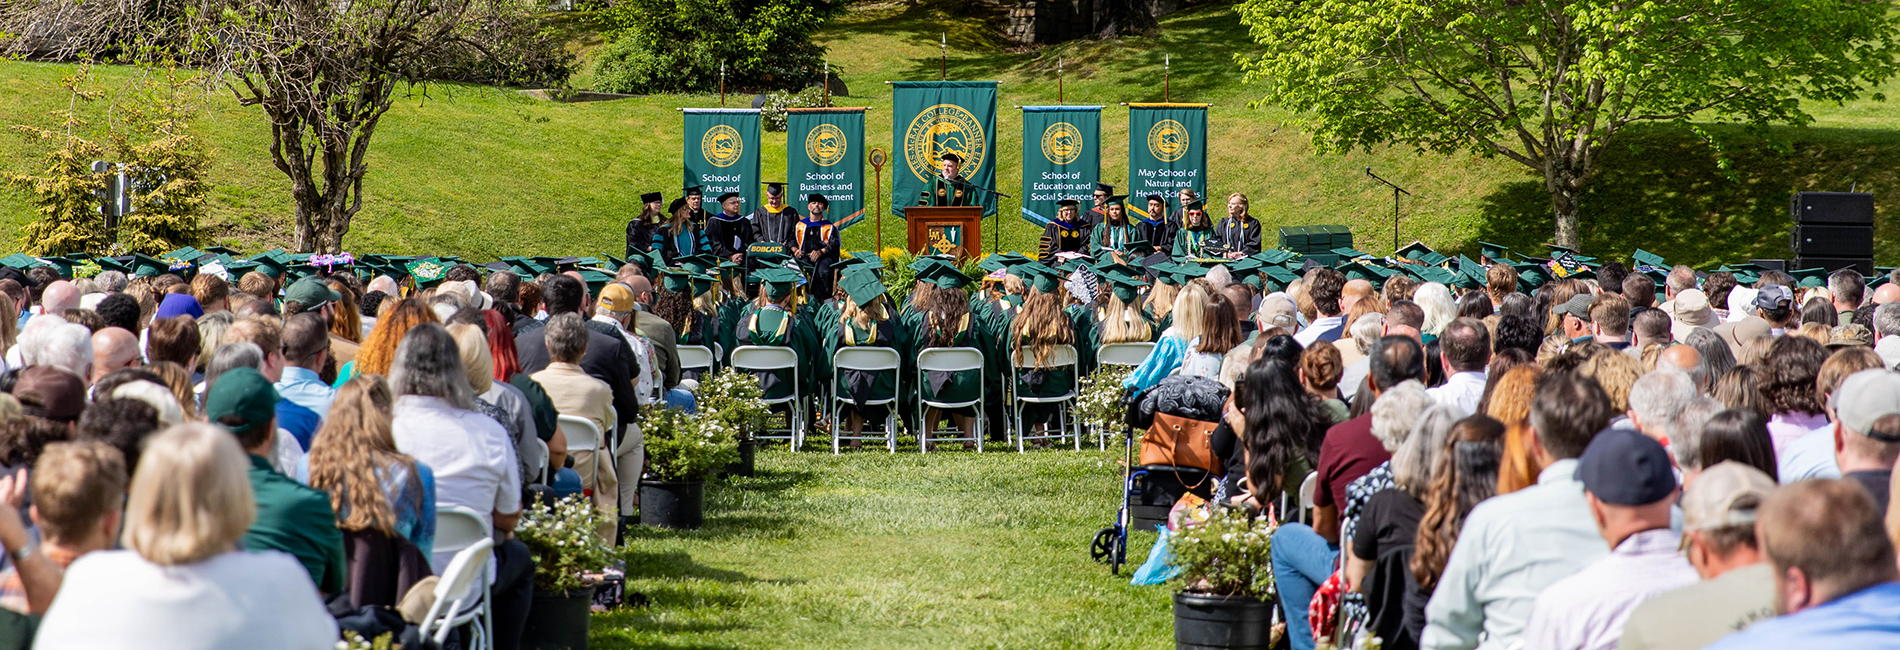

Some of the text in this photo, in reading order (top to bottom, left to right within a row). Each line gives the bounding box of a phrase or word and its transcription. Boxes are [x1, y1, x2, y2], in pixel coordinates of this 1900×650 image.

[921, 108, 960, 122] COLLEGE
[962, 115, 982, 149] BANNER
[806, 172, 845, 180] School of
[1042, 171, 1081, 180] School of
[1138, 169, 1197, 178] May School of
[702, 174, 741, 182] School of
[800, 183, 835, 191] Business
[1075, 182, 1091, 190] and
[799, 193, 853, 201] Mement
